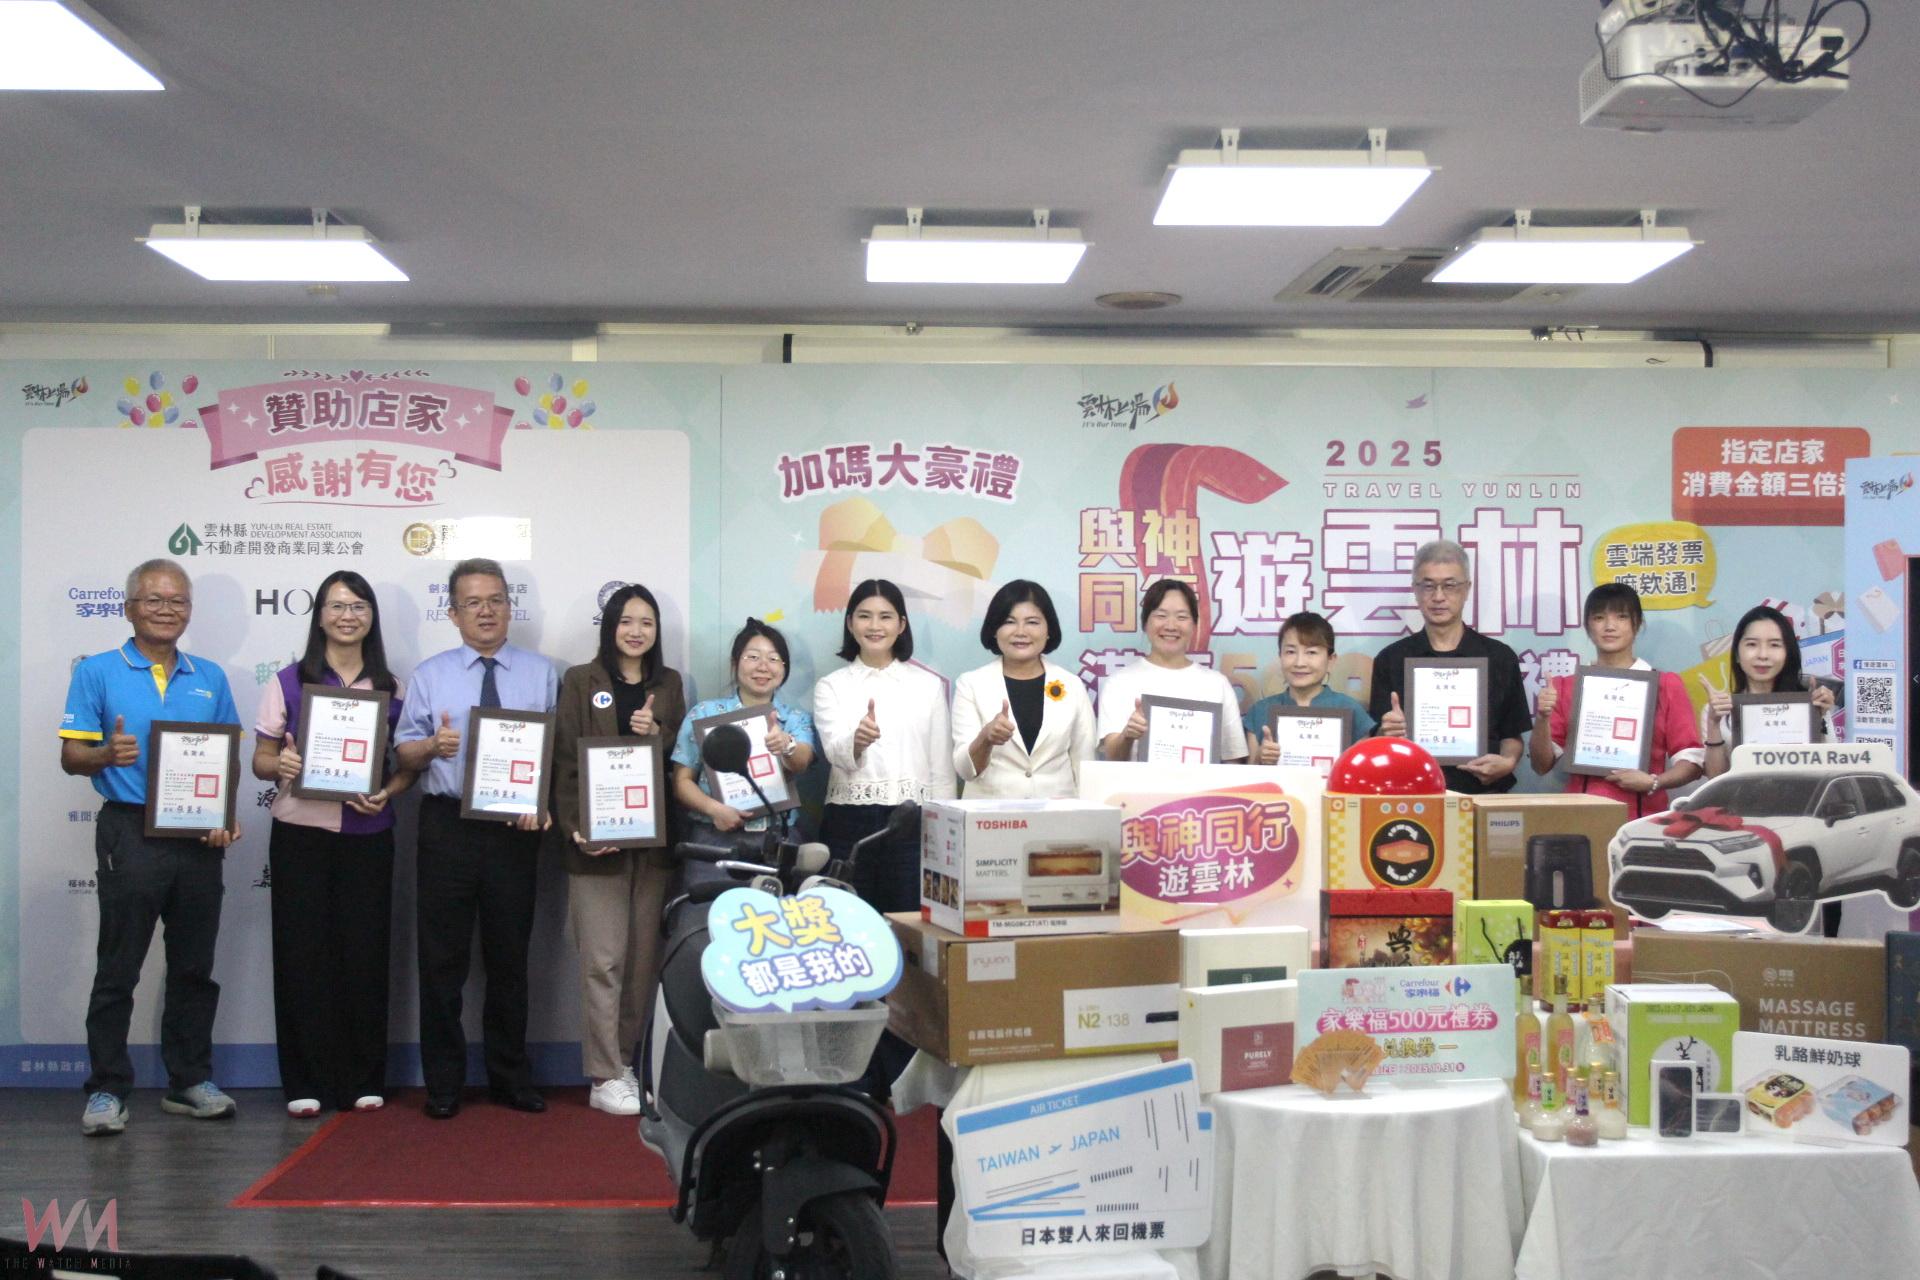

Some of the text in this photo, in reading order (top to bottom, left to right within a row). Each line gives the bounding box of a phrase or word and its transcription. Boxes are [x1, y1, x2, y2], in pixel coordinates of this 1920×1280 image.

[1326, 439, 1443, 468] 2025
[1721, 438, 1825, 466] 指定店家
[264, 449, 440, 503] 感謝有您
[777, 442, 1020, 500] 加碼大豪禮
[1323, 482, 1582, 499] TRAVEL YUNLIN
[204, 523, 248, 537] 雲林縣
[250, 523, 333, 531] YUN-LIN REAL ESTATE
[250, 531, 362, 539] DEVELOPMENT ASSOCIATION
[1078, 507, 1201, 568] 與神
[204, 541, 364, 555] 不動產開發商業同業公會
[1606, 540, 1704, 567] 雲端發票
[1752, 750, 1871, 765] TOYOTA Rav4
[975, 819, 1028, 830] TOSHIBA
[1121, 802, 1291, 864] 與神同行
[1489, 820, 1521, 828] PHILIPS
[975, 859, 1018, 867] SIMPLICITY
[1158, 857, 1255, 898] 遊雲林
[732, 896, 842, 956] 大獎
[740, 944, 873, 996] 都是我的
[1322, 1005, 1493, 1032] 家樂福500元禮券
[1759, 998, 1856, 1017] MASSAGE
[1078, 1013, 1101, 1029] N2
[1759, 1018, 1867, 1037] MATTRESS
[1244, 1050, 1272, 1060] PURELY
[1775, 1044, 1862, 1068] 乳酪鮮奶球
[1029, 1095, 1080, 1116] AIR TICKET
[977, 1126, 1121, 1173] TAIWAN JAPAN
[1021, 1220, 1166, 1246] 日本雙人來回機票
